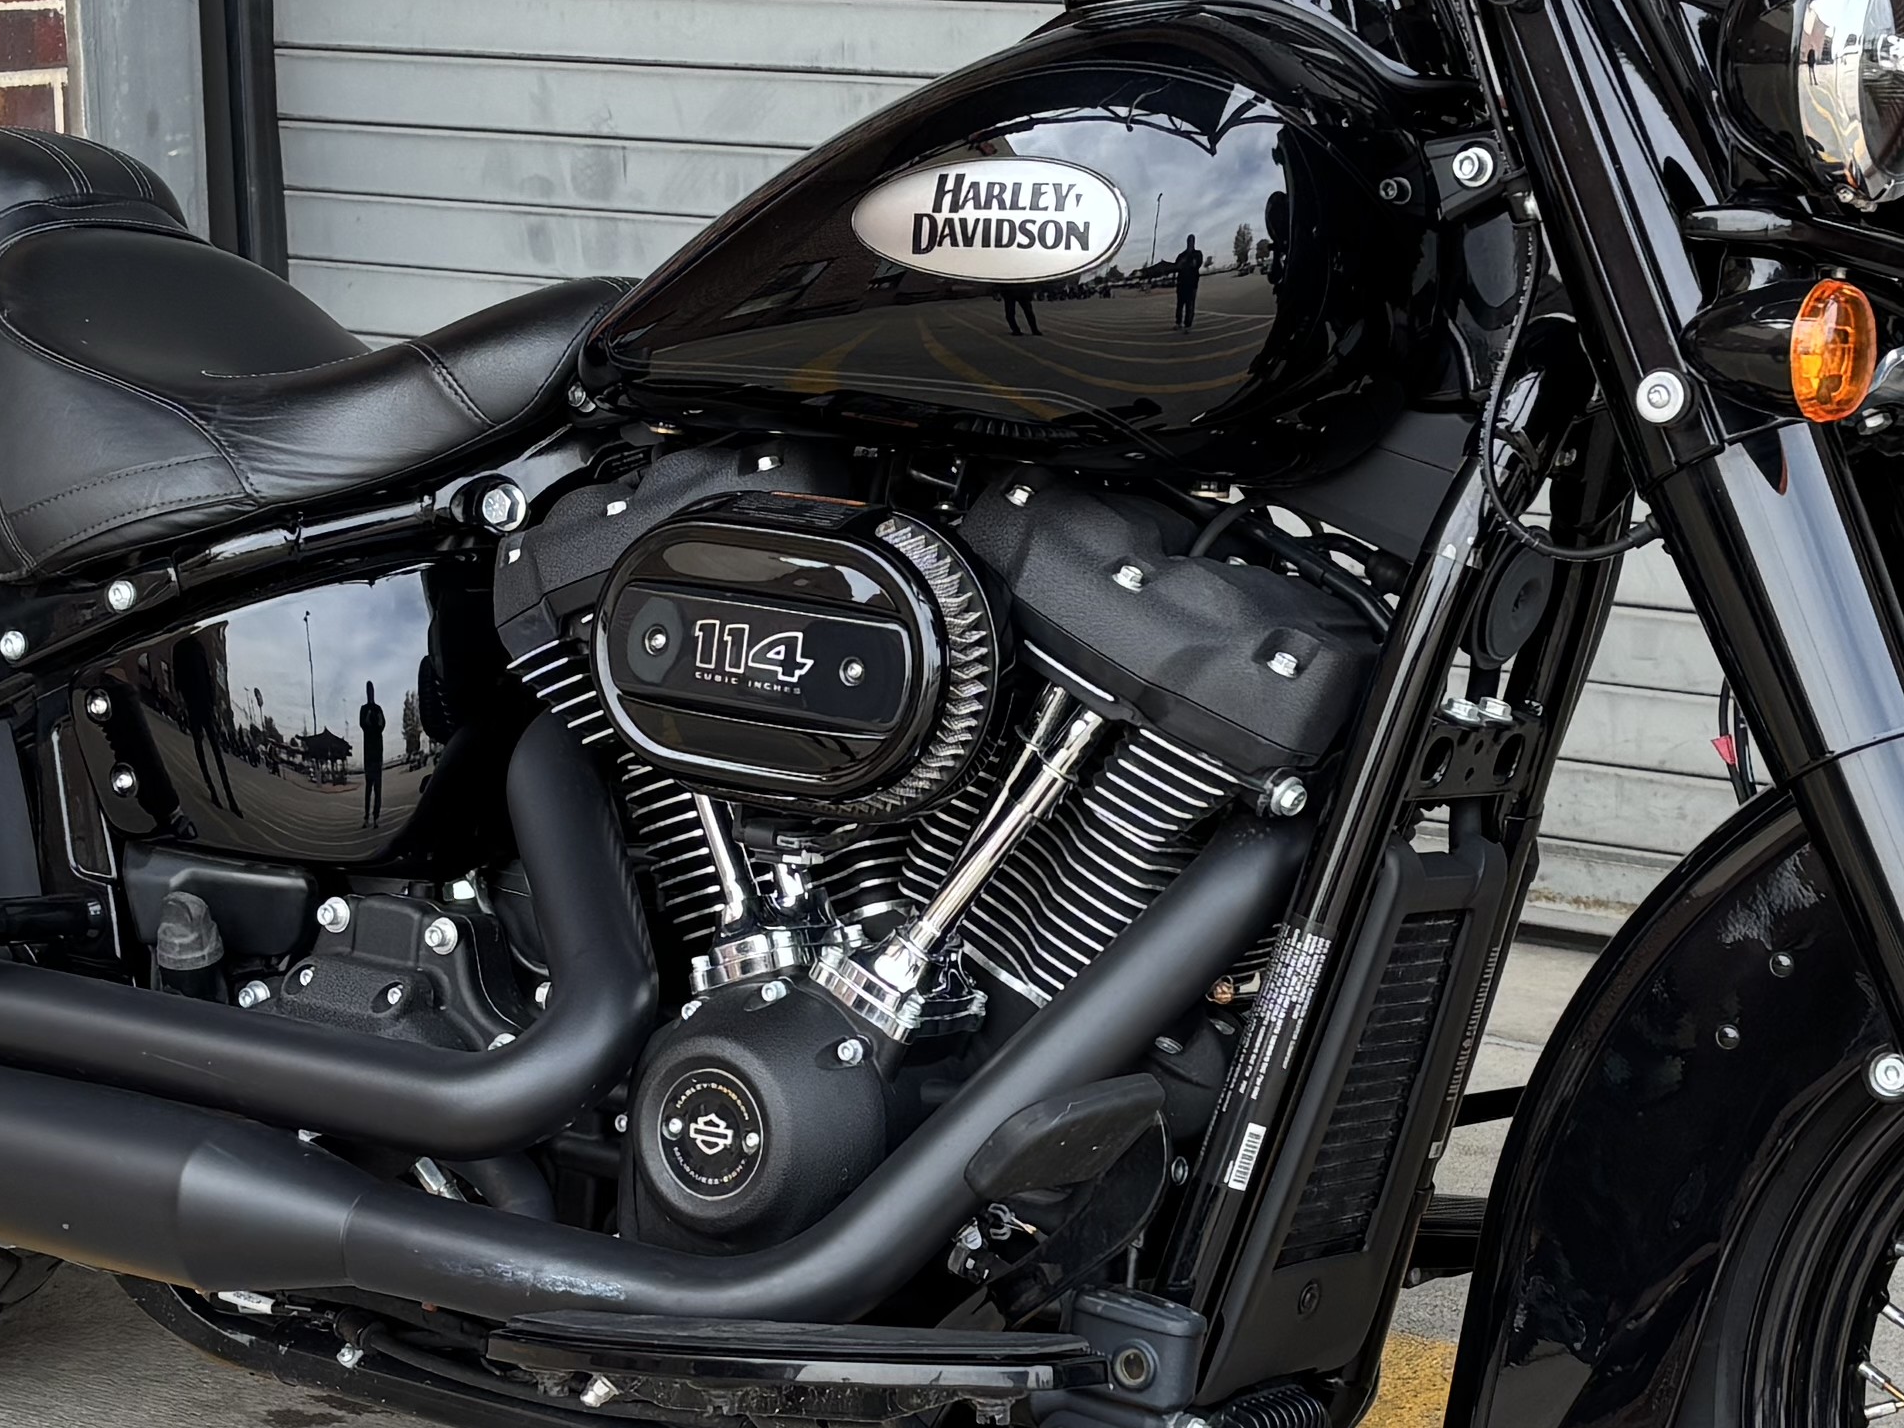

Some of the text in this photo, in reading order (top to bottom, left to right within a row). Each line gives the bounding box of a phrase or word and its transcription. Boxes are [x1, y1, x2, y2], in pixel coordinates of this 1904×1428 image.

[911, 213, 1091, 255] DAVIDSON
[694, 618, 815, 683] 114
[694, 671, 801, 695] CUBIC INCHES
